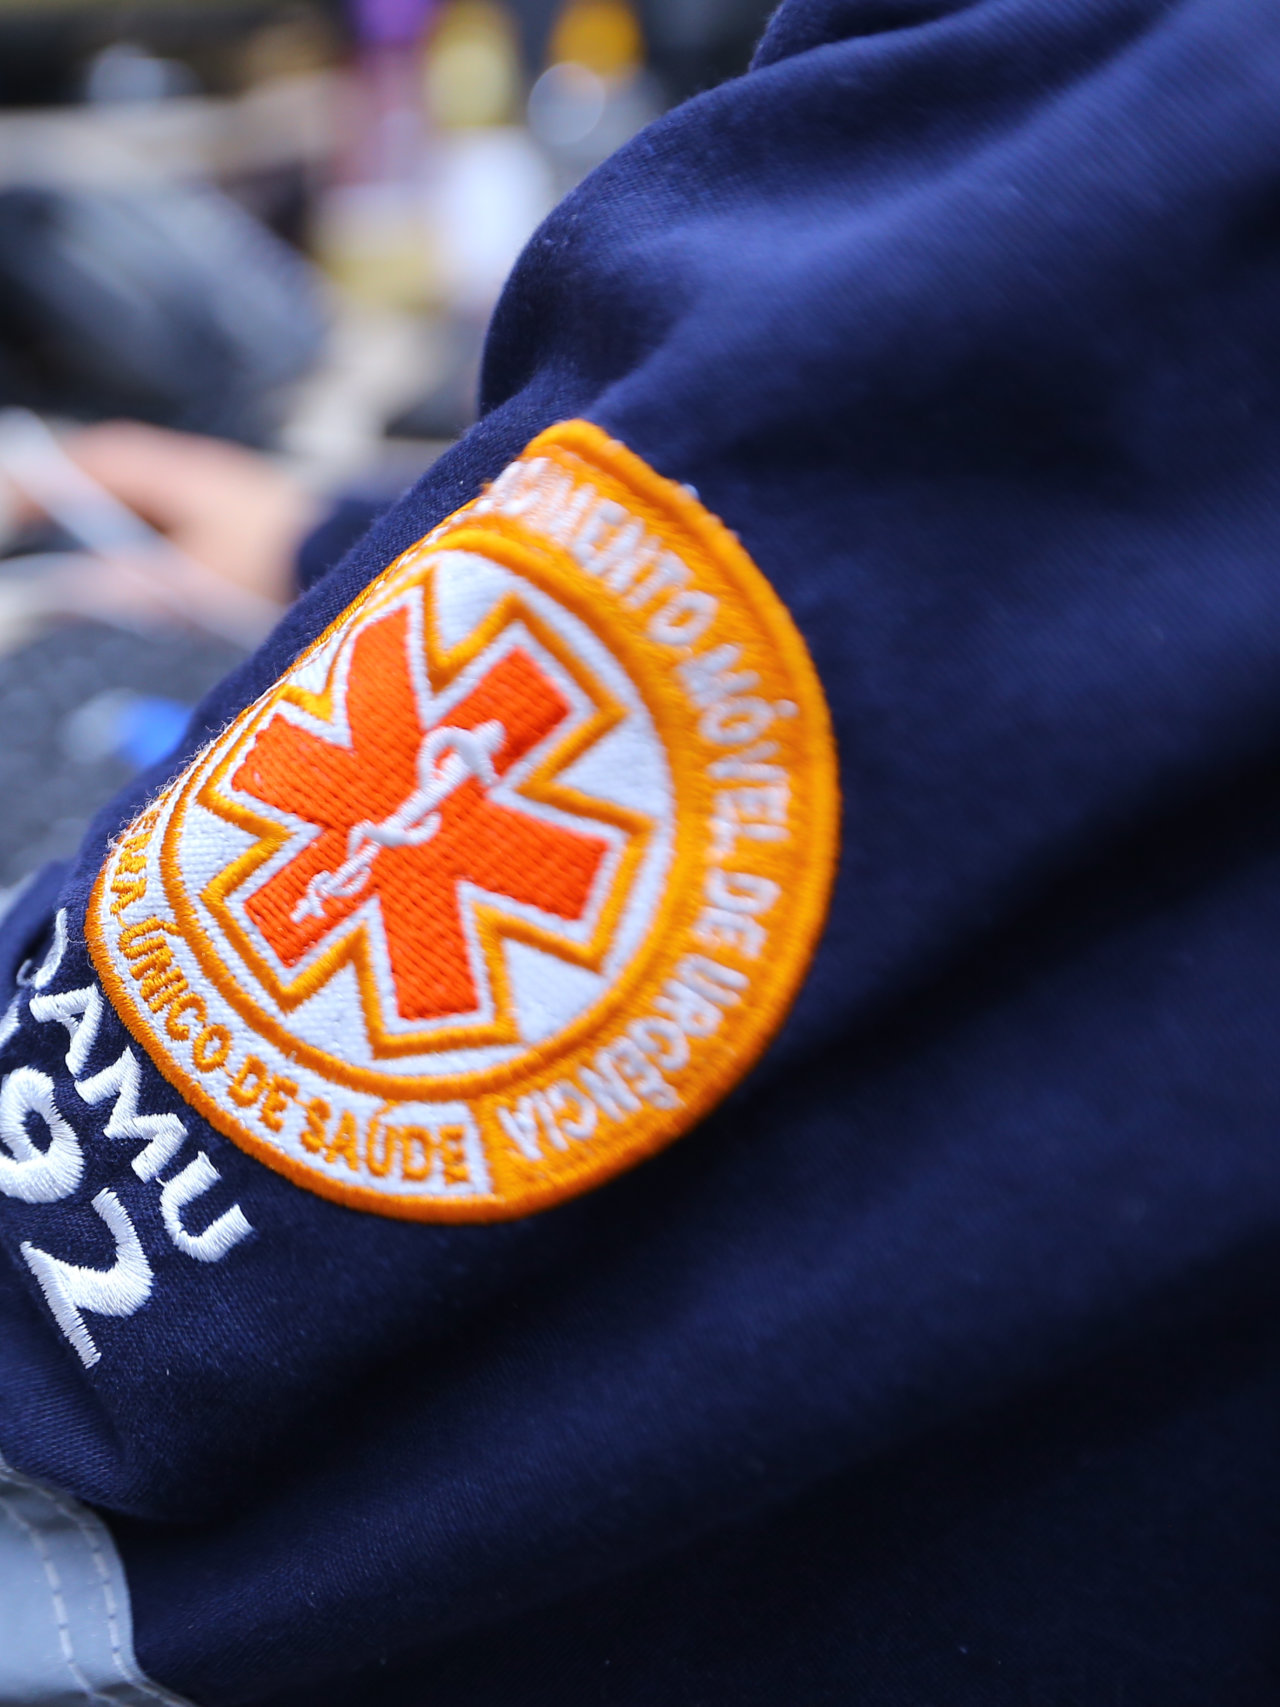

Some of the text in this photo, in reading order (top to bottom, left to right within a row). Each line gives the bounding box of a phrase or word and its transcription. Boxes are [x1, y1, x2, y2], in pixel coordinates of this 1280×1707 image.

[675, 642, 800, 860] MÓVEL
[692, 865, 782, 960] DE
[118, 914, 232, 1073] ÚNICO
[227, 1053, 299, 1133] DE
[300, 1096, 472, 1187] SAÚDE
[496, 952, 751, 1162] URGÊNCIA
